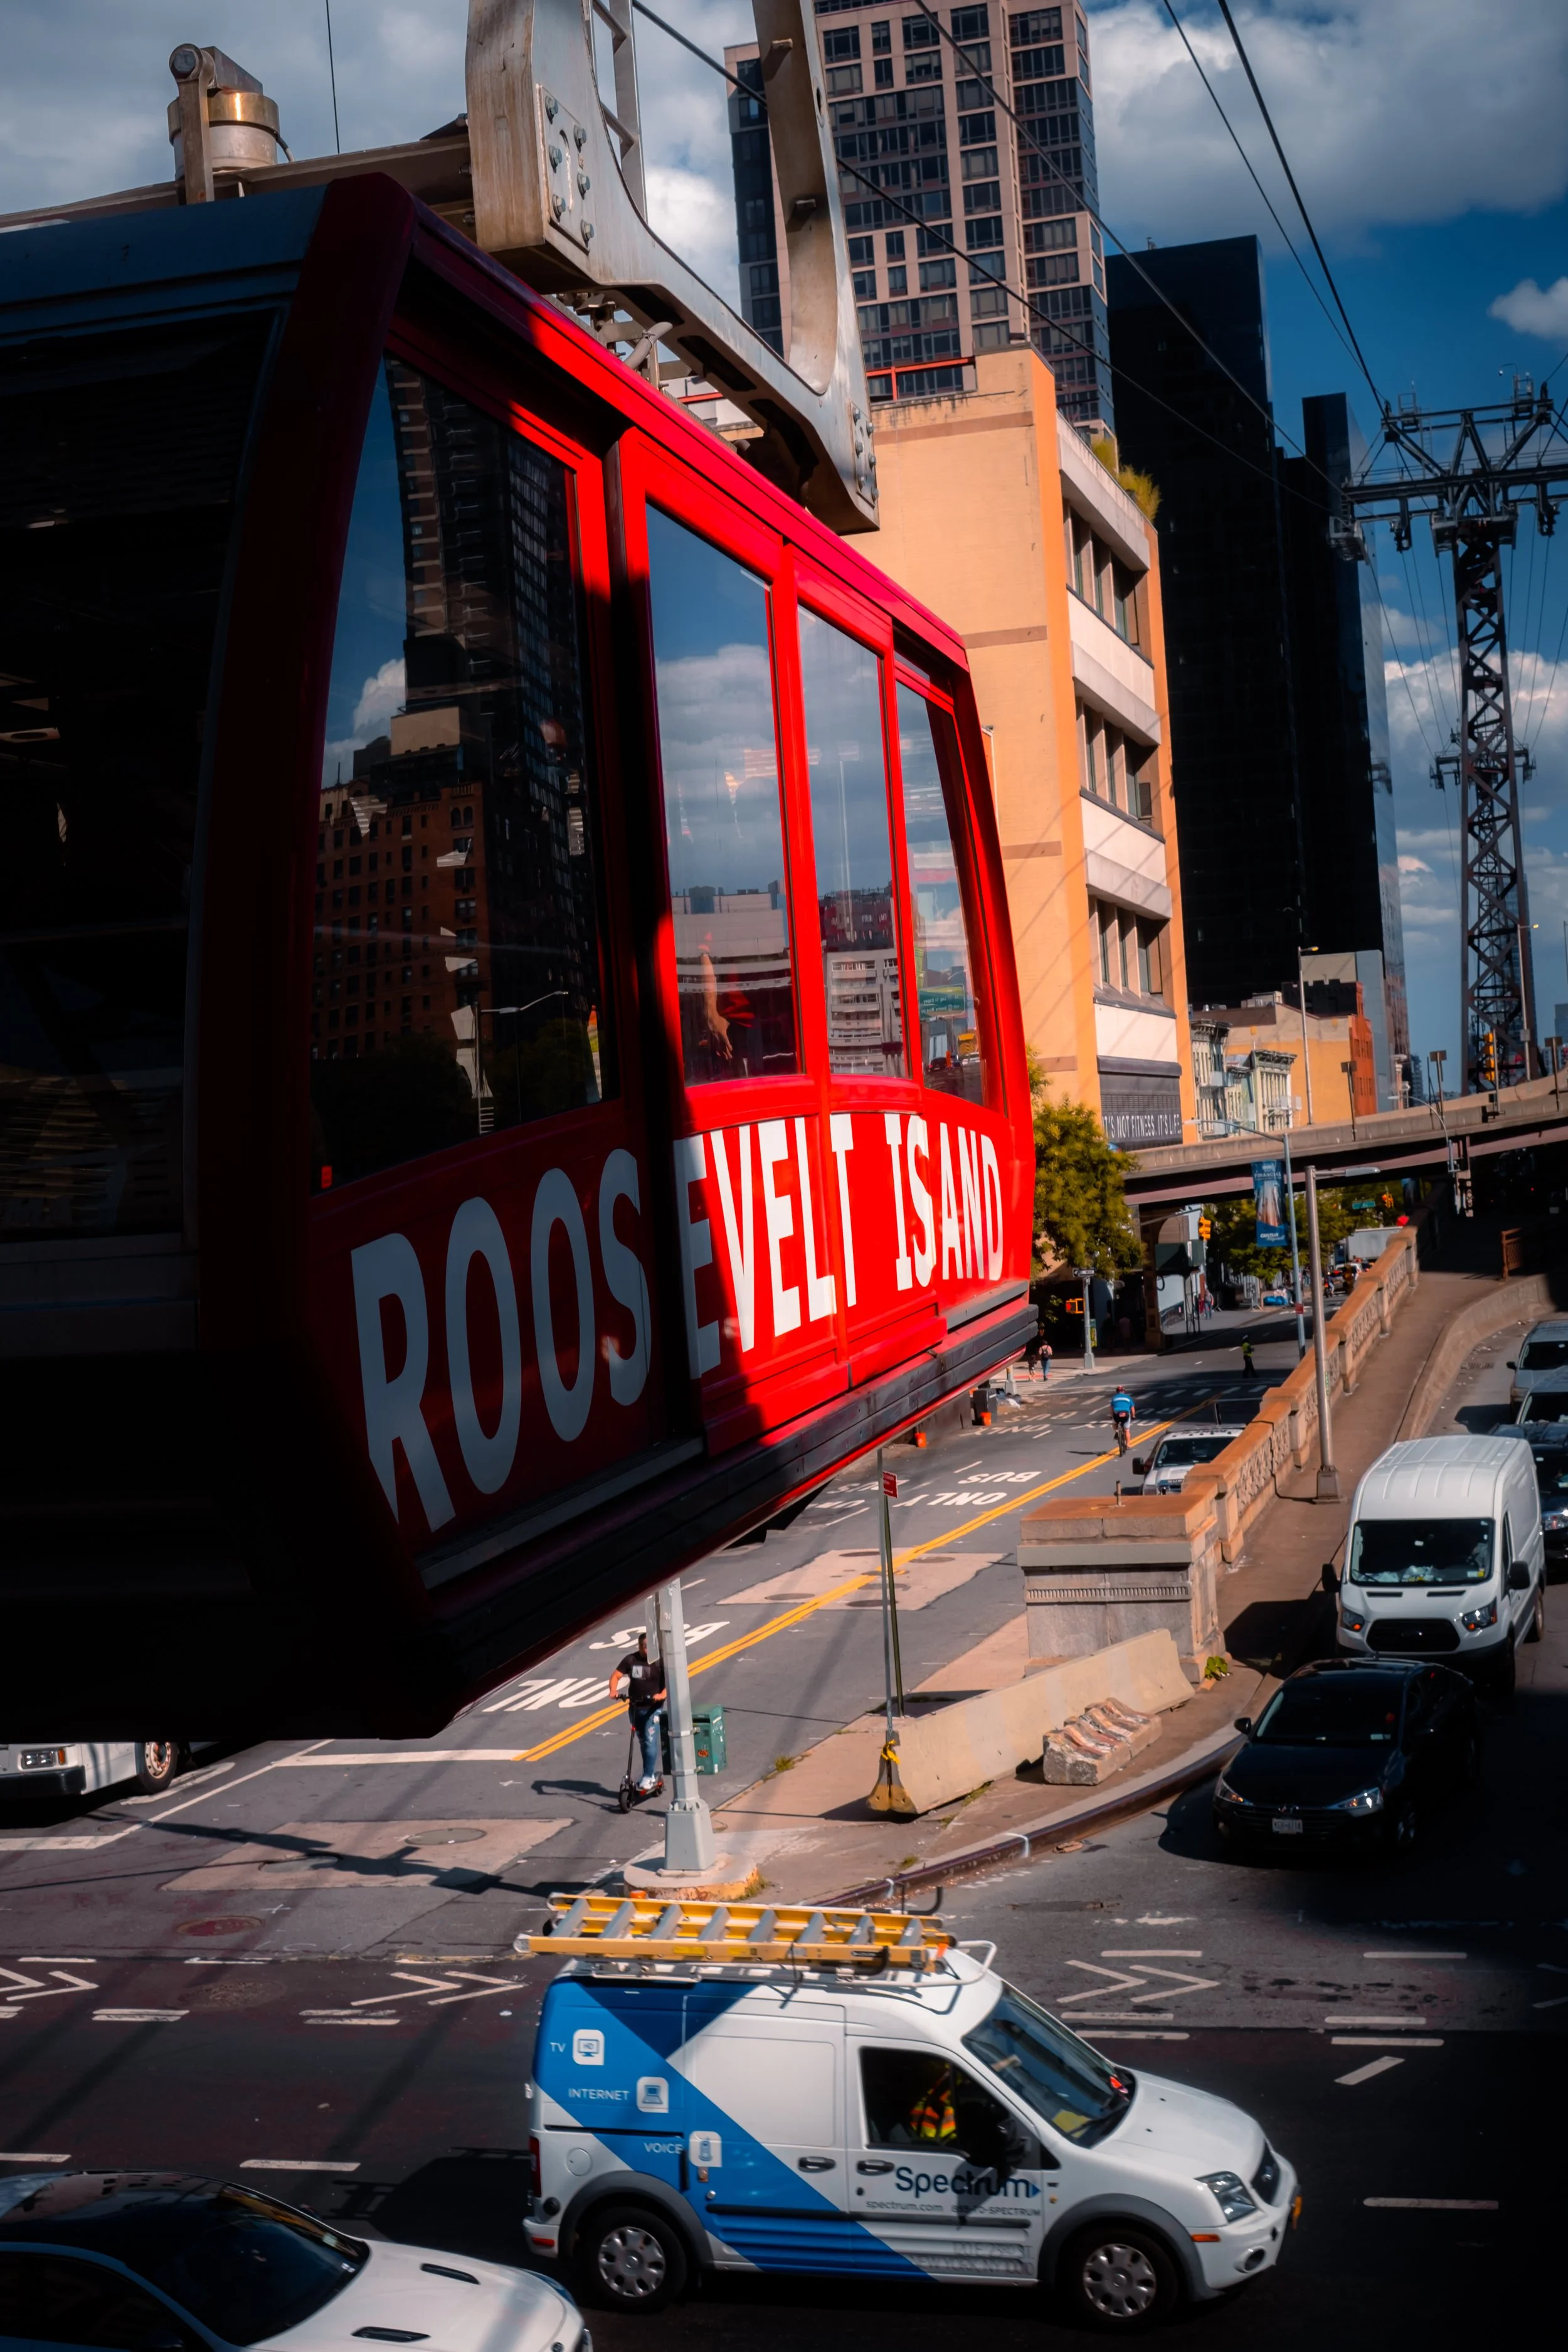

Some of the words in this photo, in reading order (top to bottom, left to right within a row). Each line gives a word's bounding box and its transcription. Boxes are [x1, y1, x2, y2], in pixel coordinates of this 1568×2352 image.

[1117, 1115, 1130, 1138] NOT
[1158, 1114, 1168, 1136] IT'S
[351, 1113, 855, 1532] ROOSEVELT
[884, 1113, 1004, 1291] ISAND
[958, 1471, 1042, 1485] BUS
[891, 1492, 1008, 1508] ONLY
[589, 1621, 730, 1650] BS
[482, 1677, 631, 1712] ONL
[549, 2042, 566, 2053] TV
[568, 2088, 630, 2100] INTERNET
[644, 2142, 684, 2154] VOICE
[895, 2166, 1030, 2198] Spectrum
[866, 2200, 944, 2213] spectrum.com
